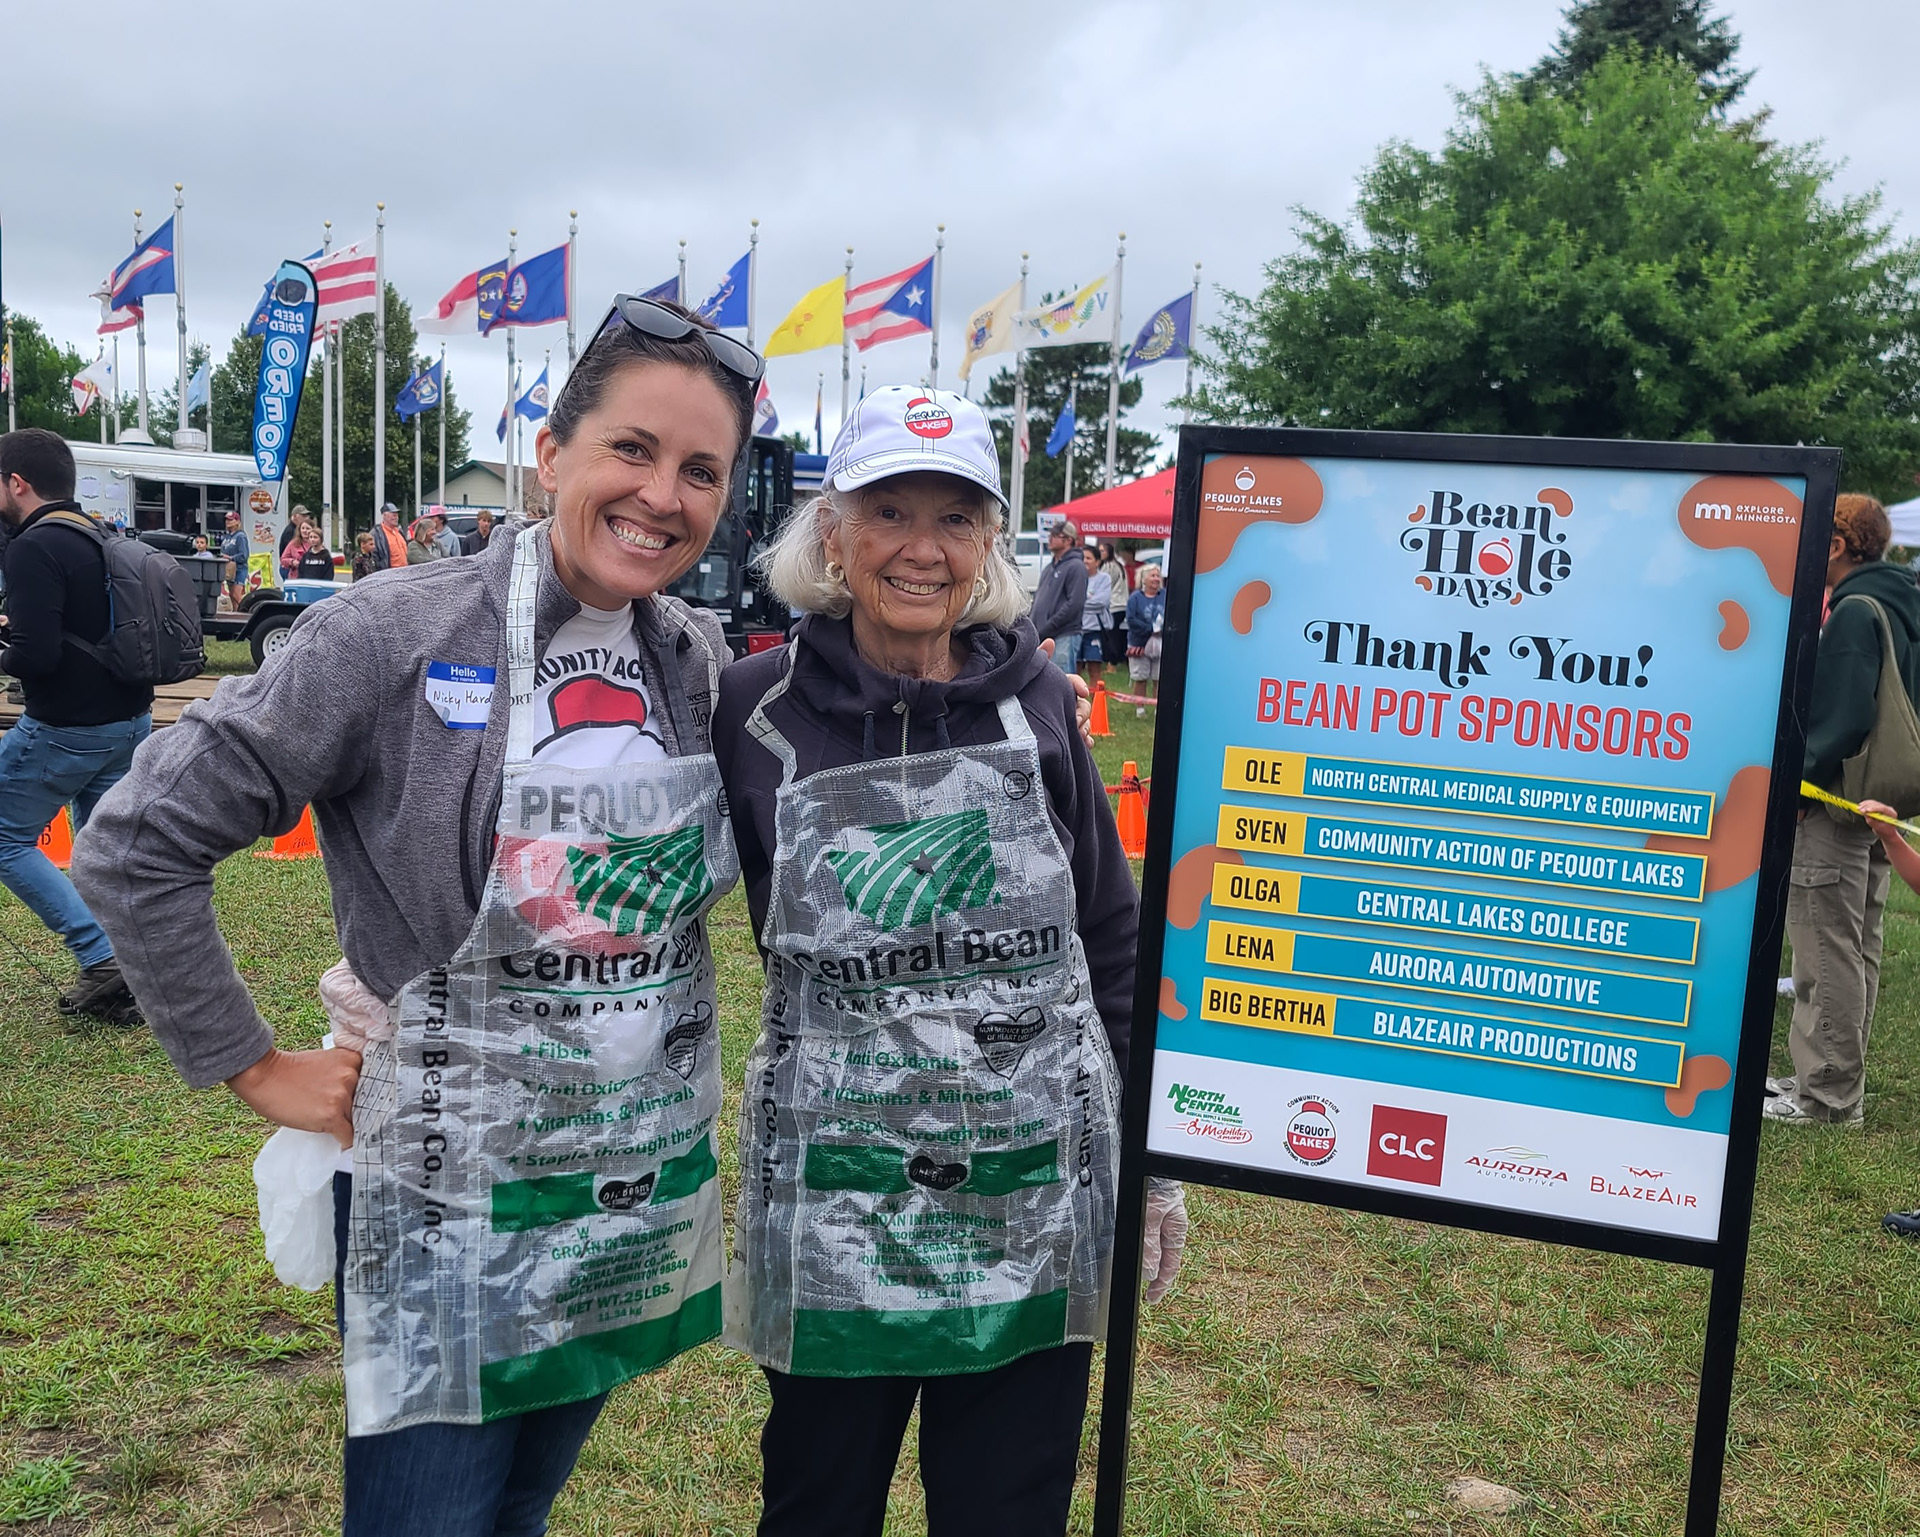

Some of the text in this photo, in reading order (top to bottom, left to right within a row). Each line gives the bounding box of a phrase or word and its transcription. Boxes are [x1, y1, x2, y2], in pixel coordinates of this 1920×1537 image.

[907, 410, 946, 421] PEQUOT
[913, 421, 948, 430] LAKES
[1204, 493, 1283, 507] PEQUOT LAKES
[1081, 522, 1106, 532] GLORIA
[1106, 523, 1118, 532] DEI
[1119, 523, 1156, 533] LUTHERAN
[1424, 489, 1567, 545] Bean
[1399, 526, 1572, 597] Hole
[1434, 576, 1512, 608] DAYS
[1303, 620, 1655, 690] Thank You!
[450, 666, 477, 677] Hello
[1256, 678, 1692, 761] BEAN POT SPONSORS
[1245, 759, 1702, 825] OLE NORTH CENTRAL MEDICAL SUPPLY & EQUIPMENT
[1235, 817, 1685, 889] SVEN COMMUNITY ACTION OF PEQUOT LAKES
[1230, 876, 1629, 946] OLGA CENTRAL LAKES COLLEGE
[500, 942, 668, 985] Central
[792, 924, 1060, 984] Central Bean
[1225, 933, 1601, 1005] LENA AURORA AUTOMOTIVE
[1208, 989, 1638, 1072] BIG BERTHA BLAZEAIR PRODUCTIONS
[538, 1042, 592, 1059] Fiber
[844, 1051, 960, 1071] Anti Oxidants
[421, 1050, 449, 1123] Bean
[537, 1083, 577, 1096] Anti
[835, 1086, 1014, 1105] Vitamins & Minerals
[1167, 1083, 1226, 1102] NORTH
[533, 1086, 695, 1133] Vitamins & Minerals
[1174, 1098, 1241, 1116] CENTRAL
[1287, 1095, 1340, 1114] COMMUNITY ACTION
[978, 1125, 1010, 1139] the
[1013, 1117, 1045, 1139] ages
[1074, 1089, 1093, 1188] Central
[1293, 1123, 1330, 1137] PEQUOT
[525, 1151, 589, 1167] Staple
[595, 1136, 667, 1156] through
[671, 1126, 692, 1145] the
[1292, 1135, 1330, 1150] LAKES
[1378, 1132, 1436, 1161] CLC
[419, 1133, 447, 1190] Co.,
[1282, 1141, 1299, 1162] SERVING
[1310, 1149, 1338, 1167] COMMUNITY
[1464, 1155, 1569, 1182] AURORA
[1476, 1169, 1555, 1187] AUTOMOTIVE
[762, 1157, 781, 1208] Inc.
[887, 1202, 899, 1211] W
[421, 1199, 447, 1255] Inc.
[909, 1213, 922, 1227] IN
[926, 1212, 1007, 1229] WASHINGTON
[577, 1226, 589, 1239] W
[604, 1237, 617, 1251] IN
[621, 1218, 694, 1248] WASHINGTON
[886, 1231, 932, 1240] PRODUCT
[922, 1242, 948, 1254] BEAN
[580, 1253, 629, 1270] PRODUCT
[632, 1250, 644, 1260] OF
[659, 1258, 688, 1275] 98848
[569, 1269, 612, 1287] CENTRAL
[614, 1262, 643, 1275] BEAN
[878, 1274, 908, 1287] NET
[565, 1300, 594, 1318] NET
